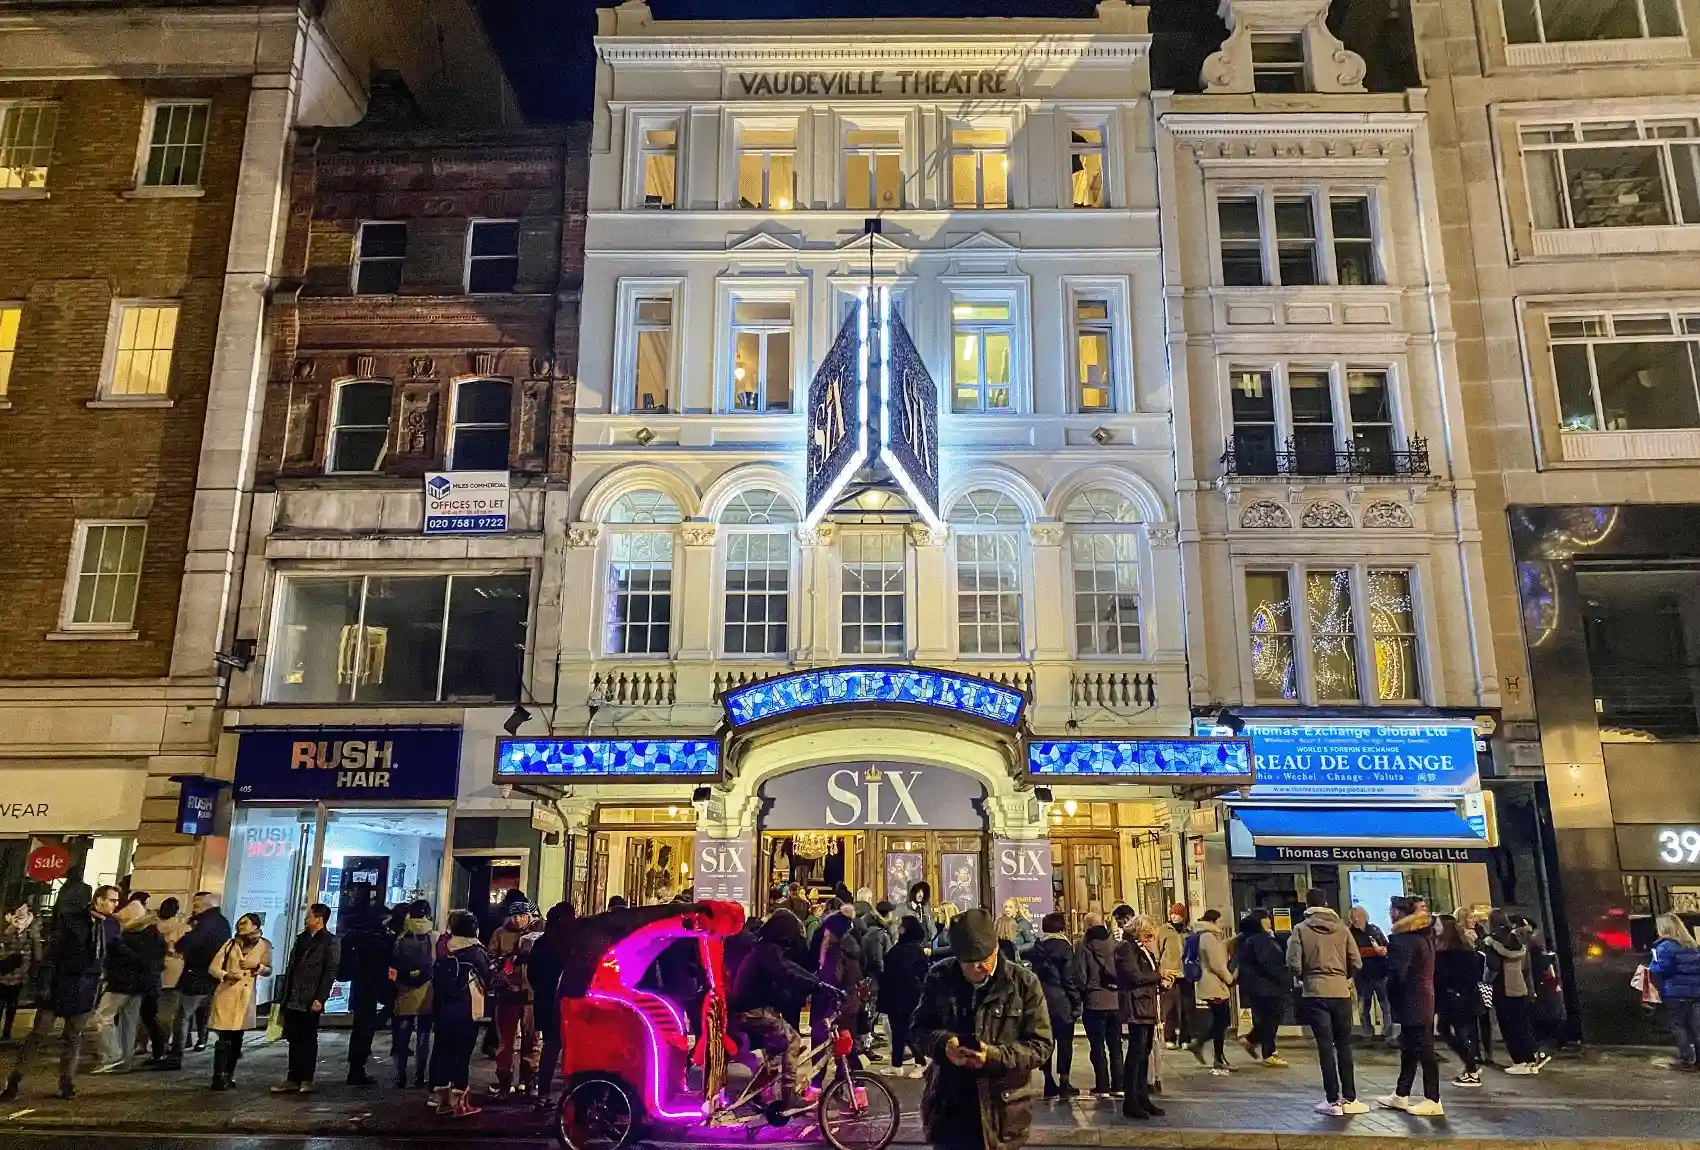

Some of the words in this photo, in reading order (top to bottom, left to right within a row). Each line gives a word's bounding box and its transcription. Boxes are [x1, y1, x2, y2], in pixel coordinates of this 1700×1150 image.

[739, 71, 883, 95] VAUDEVILLE
[896, 70, 1008, 94] THEATRE
[431, 500, 470, 509] OFFICES
[473, 500, 486, 509] TO
[489, 500, 504, 508] LET
[429, 519, 448, 528] 020
[451, 519, 474, 528] 7581
[478, 518, 503, 527] 9722
[1303, 725, 1371, 738] Exchange
[1376, 727, 1421, 737] Global
[1426, 728, 1448, 737] Ltd
[1254, 755, 1311, 770] REAU
[1320, 755, 1350, 770] DE
[1357, 755, 1455, 771] CHANGE
[336, 771, 390, 788] HAIR
[1326, 772, 1363, 783] Change
[1373, 773, 1404, 781] Valuta
[826, 769, 929, 826] SIX
[701, 846, 746, 873] SIX
[1277, 846, 1329, 859] Thomas
[1333, 847, 1396, 861] Exchange
[1400, 849, 1443, 860] Global
[1447, 849, 1468, 860] Ltd
[34, 854, 64, 869] sale
[1001, 849, 1046, 876] SIX
